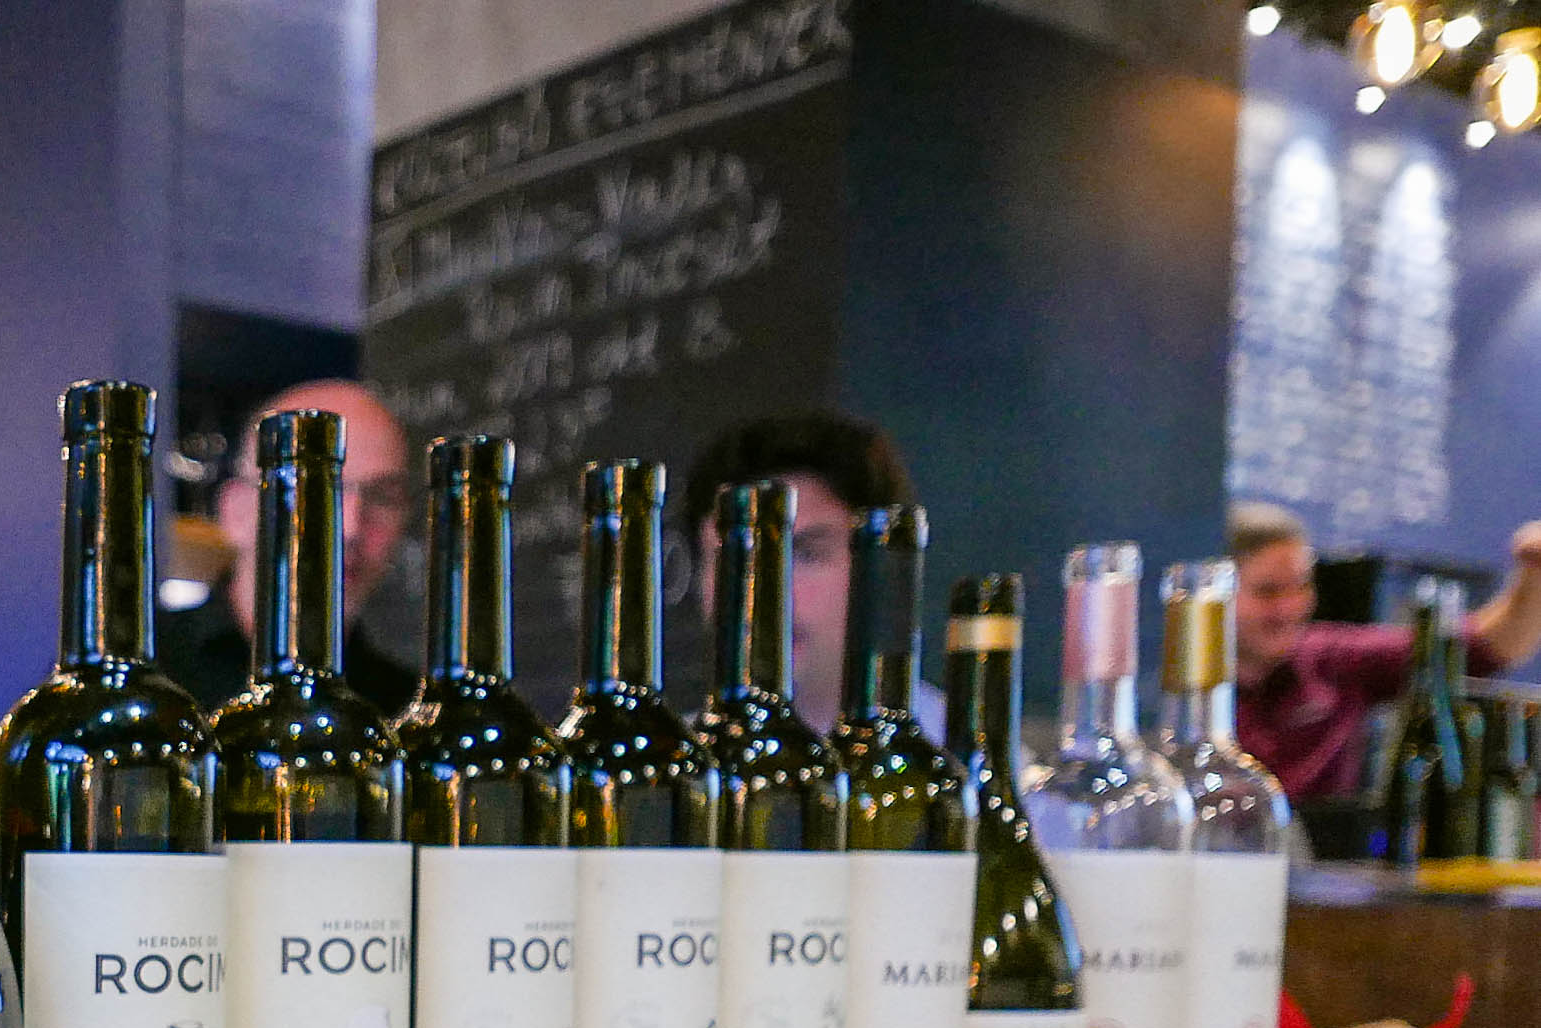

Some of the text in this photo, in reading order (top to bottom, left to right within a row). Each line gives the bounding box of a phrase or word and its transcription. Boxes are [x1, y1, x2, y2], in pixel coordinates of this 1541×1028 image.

[138, 936, 202, 948] HERDADE
[489, 937, 572, 972] ROC
[637, 933, 717, 967] ROC
[768, 932, 844, 966] ROC
